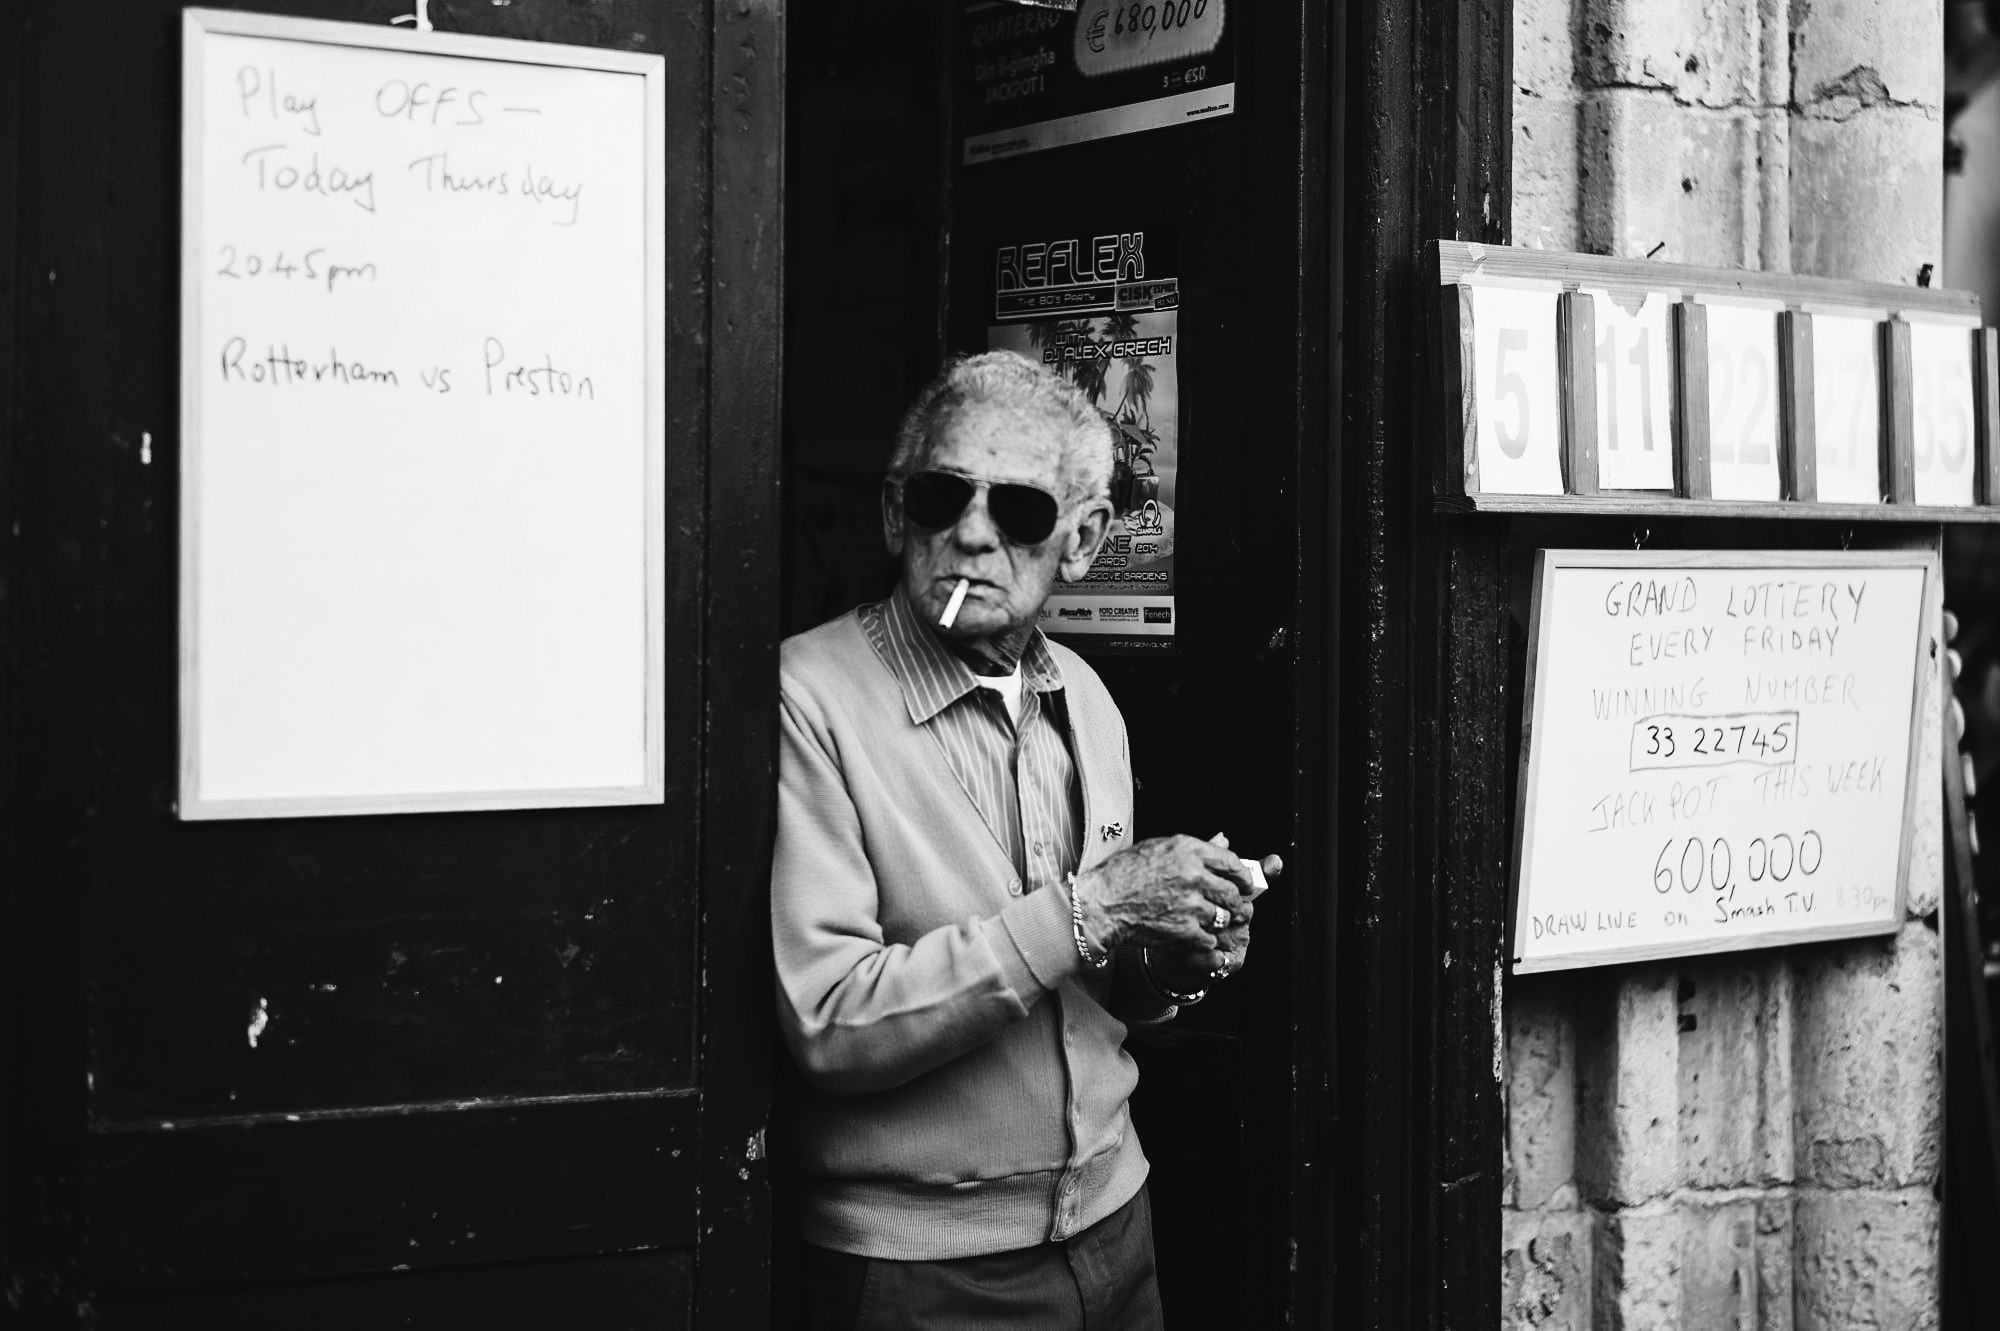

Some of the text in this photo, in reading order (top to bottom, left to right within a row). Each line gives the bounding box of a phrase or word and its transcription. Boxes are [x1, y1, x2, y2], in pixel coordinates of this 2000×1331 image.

[237, 65, 321, 135] Play
[375, 79, 487, 125] OFFS
[243, 144, 582, 225] Today Thursday
[998, 232, 1145, 289] REFLEX
[1118, 285, 1152, 302] CISK
[1044, 337, 1172, 363] DJ ALEX GRECH
[1055, 332, 1087, 346] WITH
[221, 336, 594, 400] Rotterham vs Preston
[1494, 328, 1530, 459] 5
[1595, 325, 1654, 451] 11
[1709, 341, 1770, 465] 22
[1814, 350, 1871, 469] 27
[1123, 571, 1168, 581] GARDENS
[1605, 576, 1867, 624] GRAND LOTTERY
[1144, 608, 1170, 619] Fenech
[1629, 624, 1840, 667] EVERY FRIDAY
[1592, 672, 1860, 721] WINNING NUMBER
[1646, 722, 1791, 758] 33 22745
[1753, 763, 1810, 806] THIS
[1827, 757, 1888, 796] WEEK
[1654, 829, 1823, 903] 600,000
[1532, 913, 1588, 940] DRAW
[1597, 910, 1639, 930] LIVE
[1714, 896, 1776, 924] Smash
